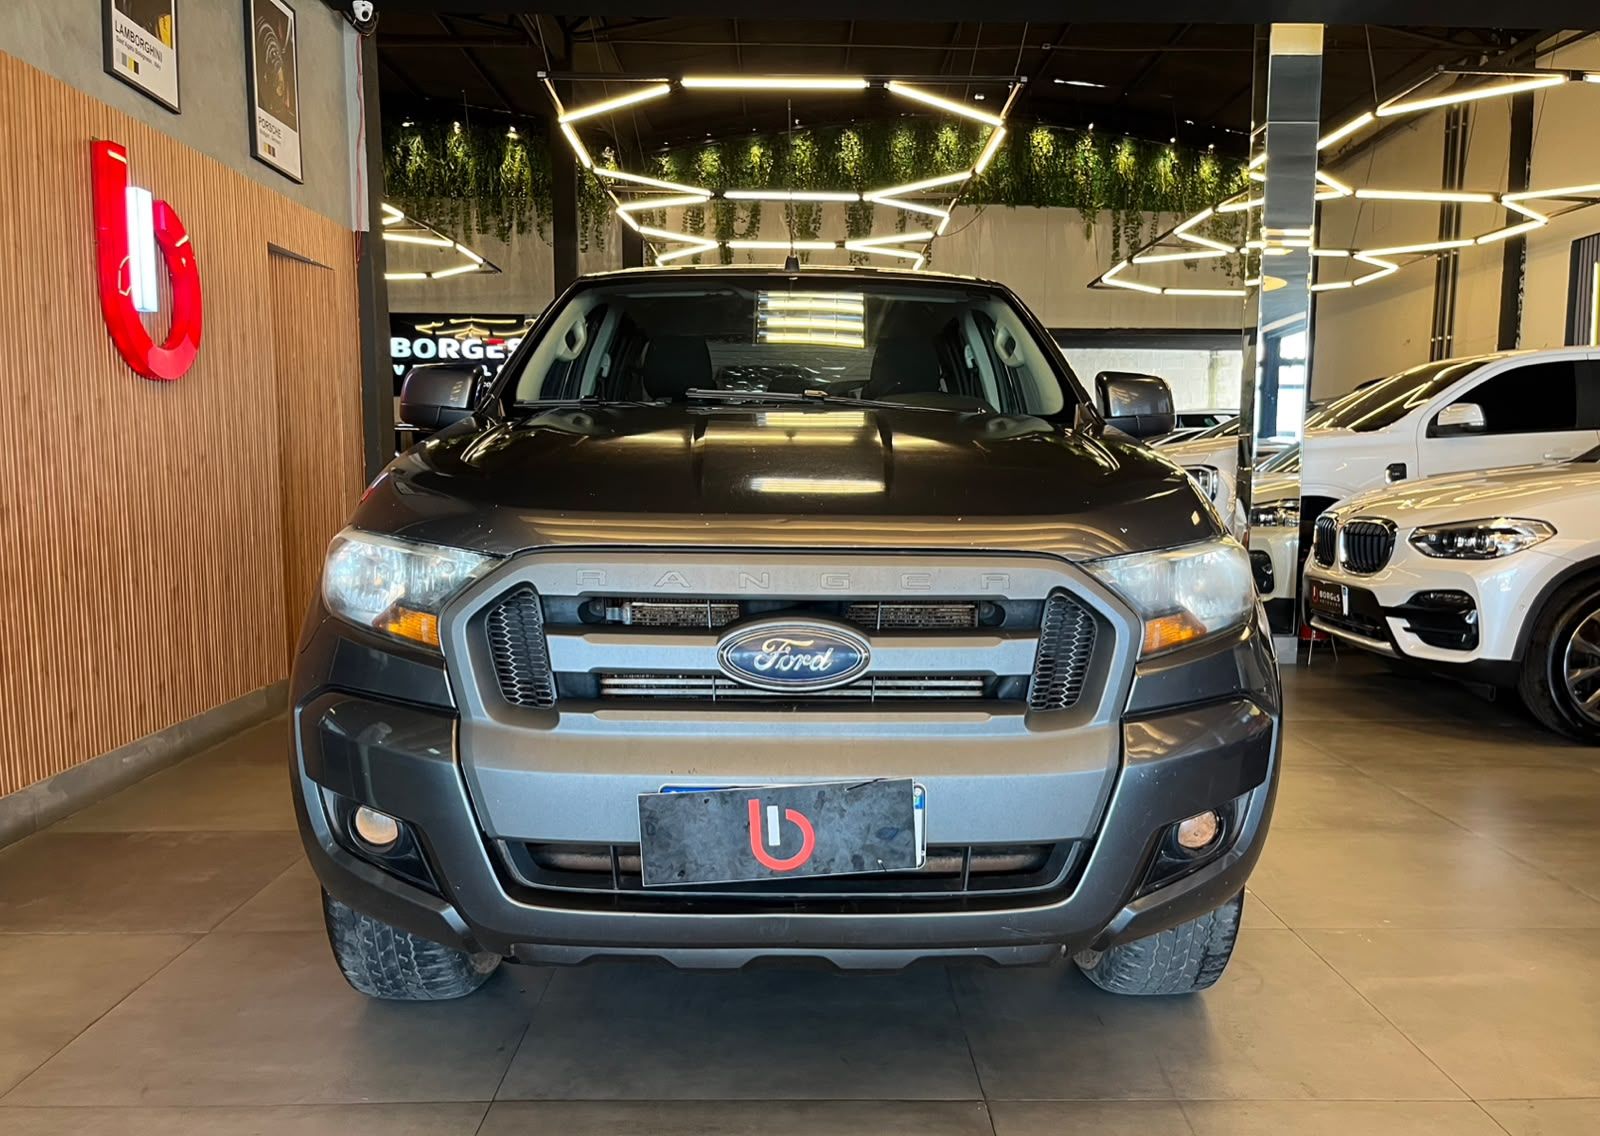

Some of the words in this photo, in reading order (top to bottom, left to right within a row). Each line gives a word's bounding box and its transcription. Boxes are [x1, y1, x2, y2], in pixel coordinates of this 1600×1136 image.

[115, 20, 162, 63] LAMBORGHINI
[258, 116, 281, 139] PORSCHE
[575, 569, 1011, 590] RANGER
[753, 638, 835, 673] Ford
